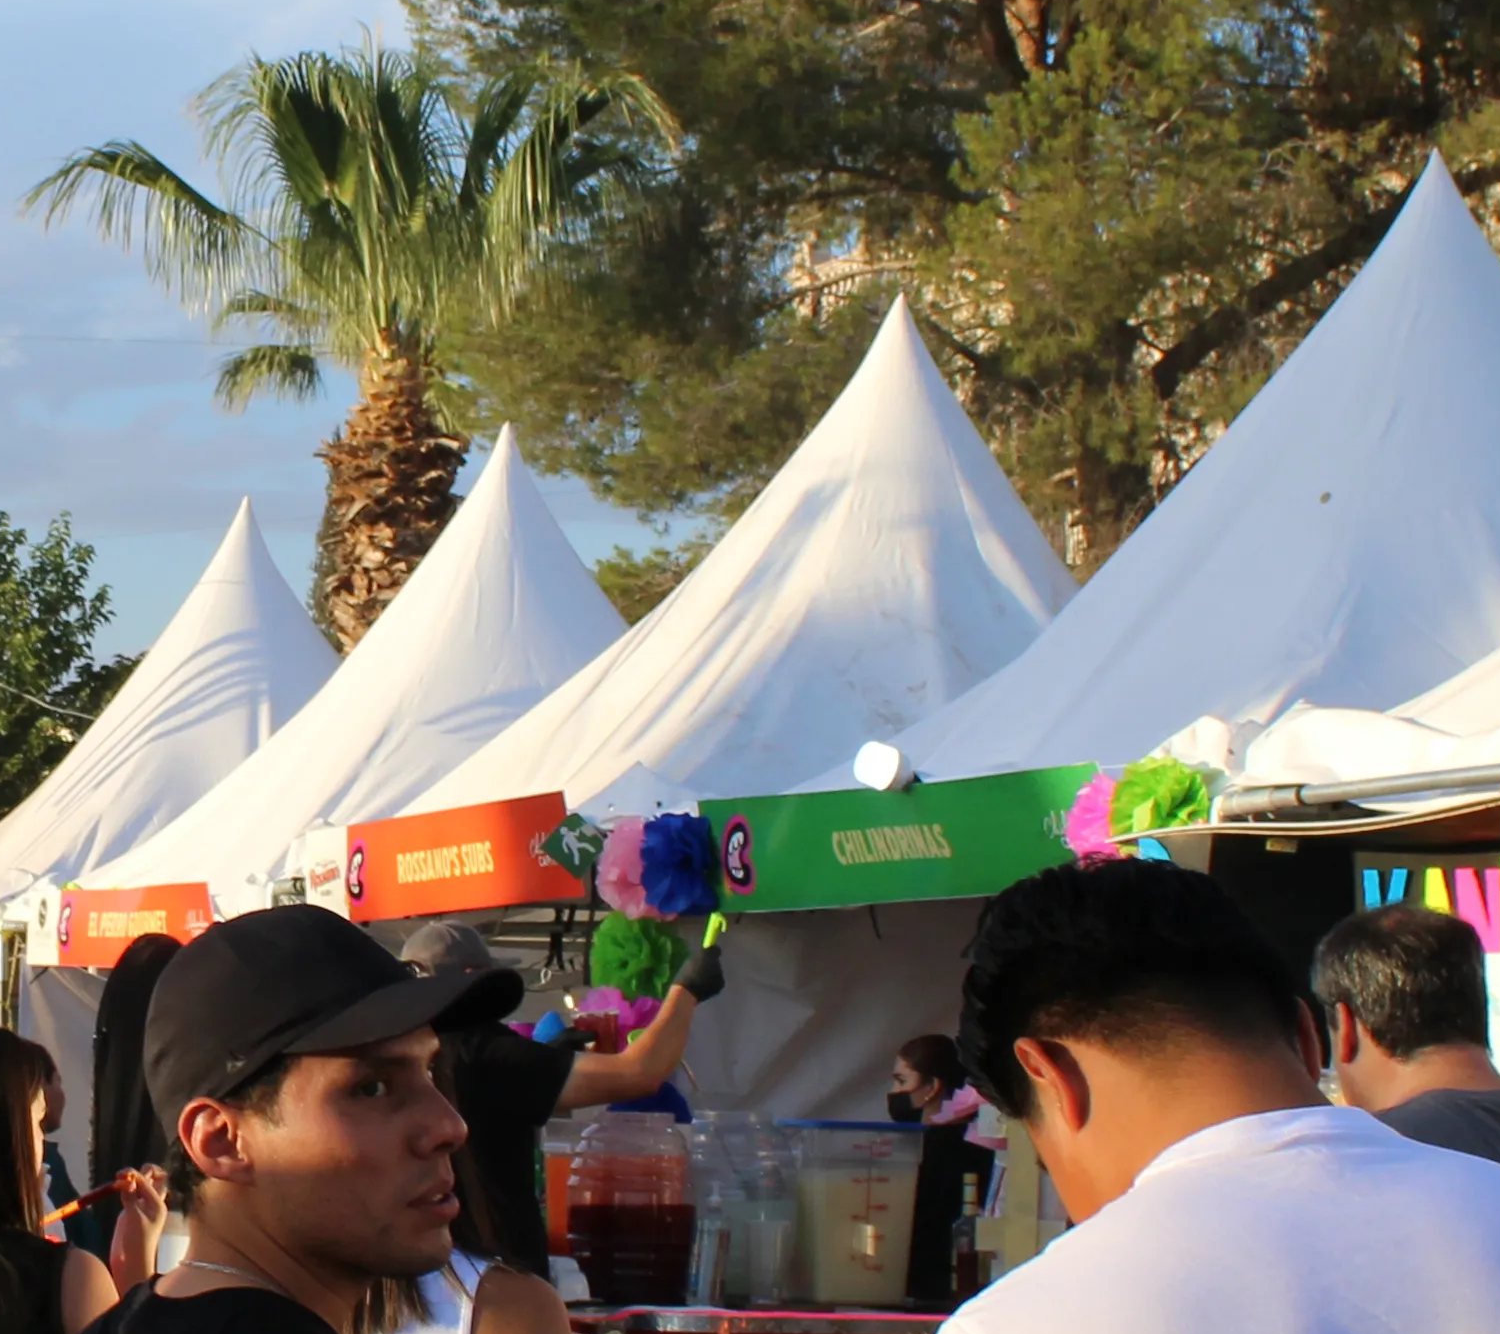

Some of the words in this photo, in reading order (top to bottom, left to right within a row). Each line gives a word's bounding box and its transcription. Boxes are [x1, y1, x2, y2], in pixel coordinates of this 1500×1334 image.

[397, 845, 459, 884] ROSSANO'S
[461, 840, 494, 875] SUBS
[832, 824, 952, 866] CHILINDRINAS
